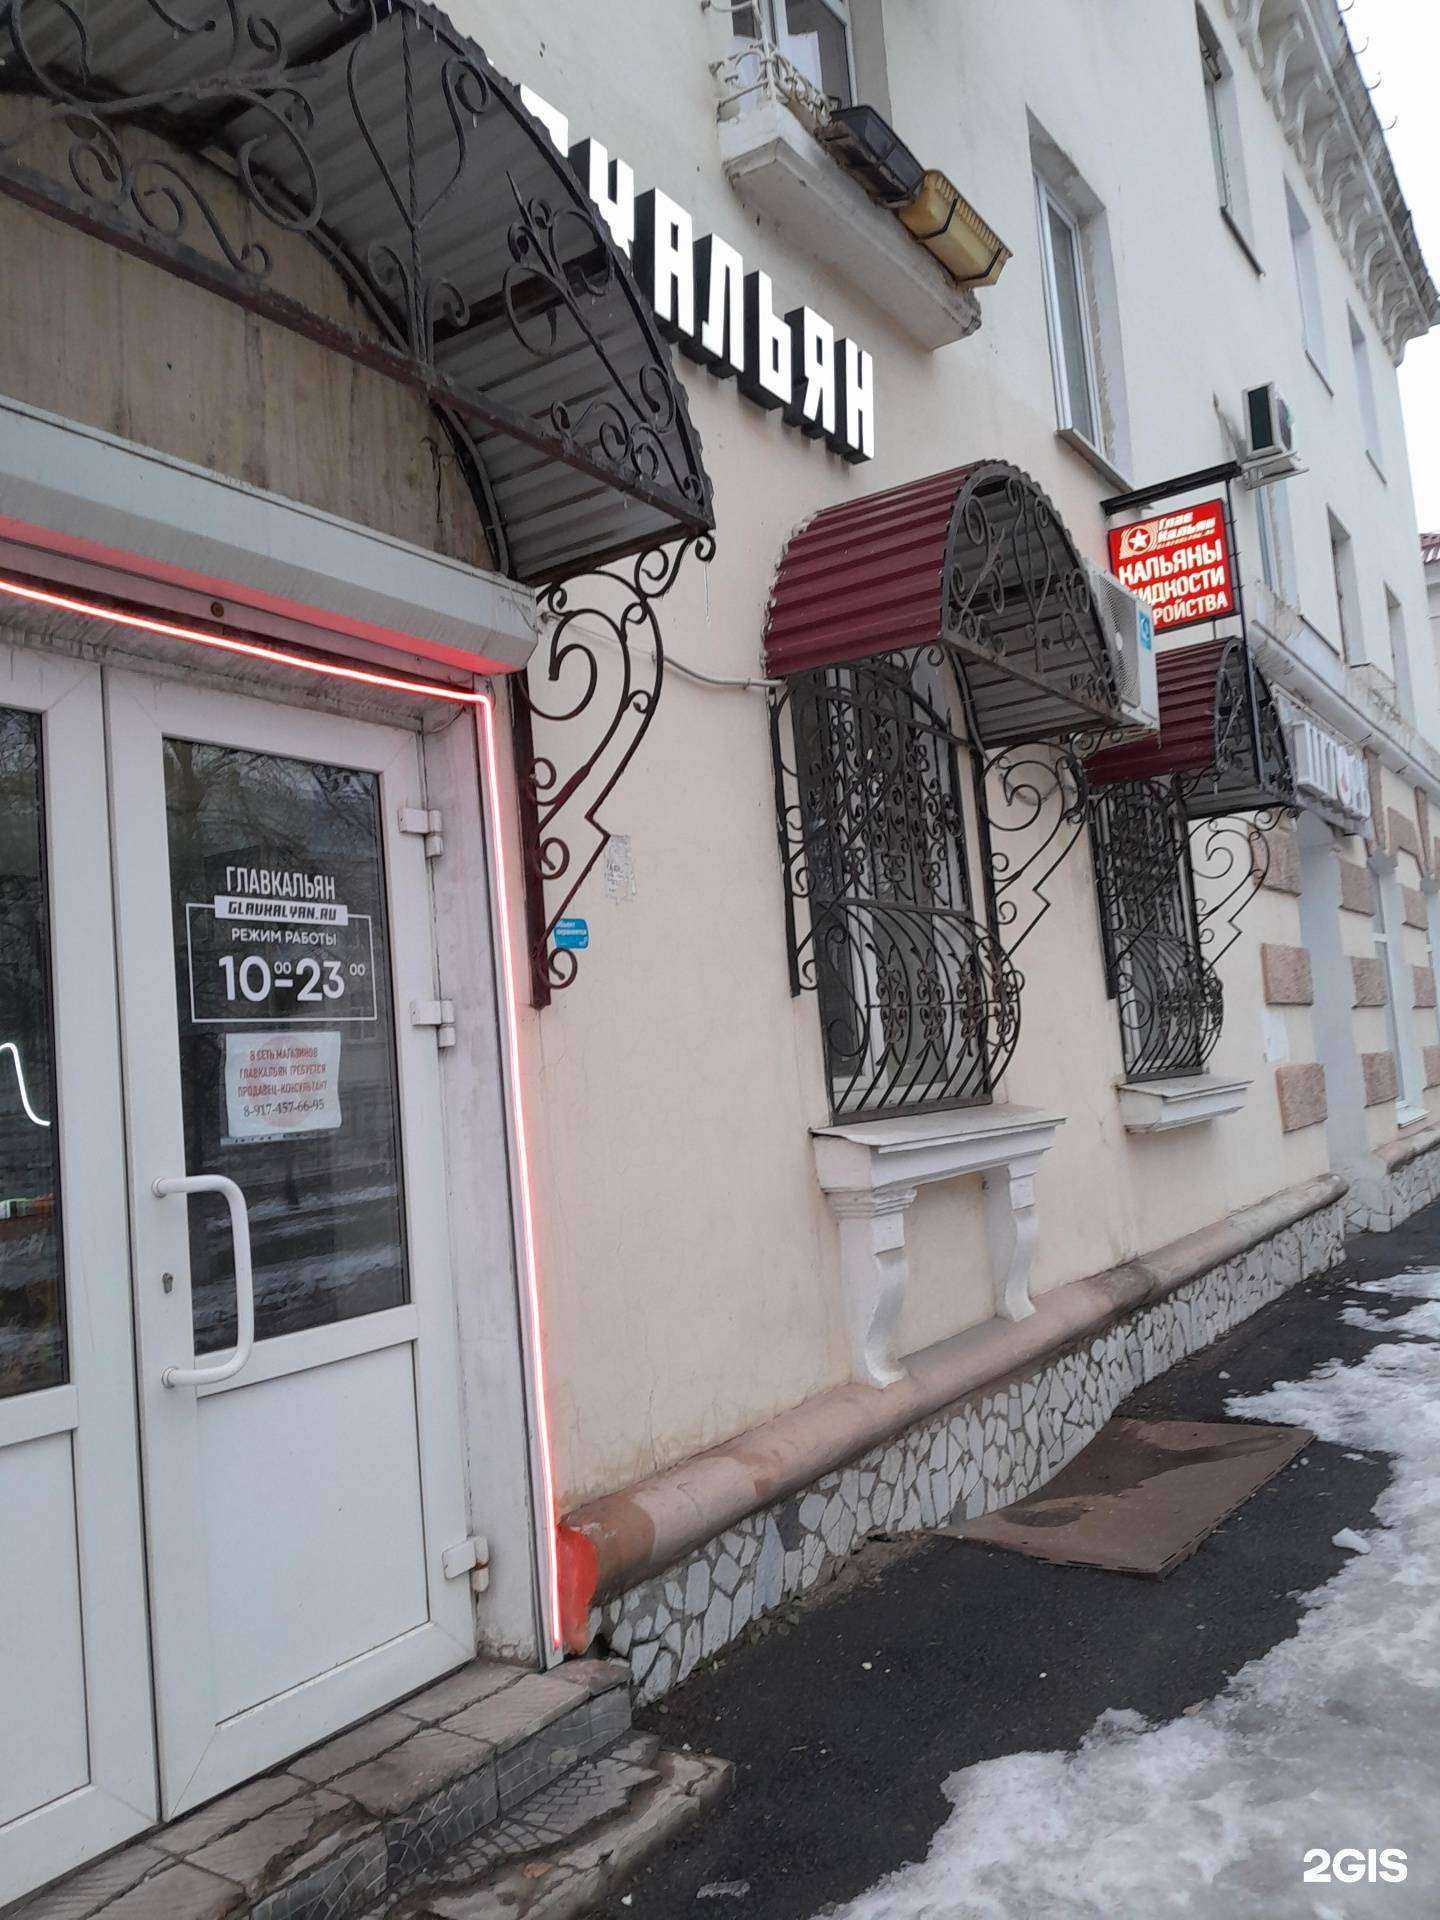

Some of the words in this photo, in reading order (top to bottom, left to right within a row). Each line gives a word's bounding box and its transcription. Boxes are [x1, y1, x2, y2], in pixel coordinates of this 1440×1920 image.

[1118, 539, 1223, 586] КАЛЬЯНЫ
[1133, 566, 1226, 606] ИДКОСТИ
[1152, 591, 1229, 625] РОЙСТВА
[226, 866, 336, 900] ГЛАВКАЛЬЯН
[232, 928, 282, 943] РЕЖИМ
[285, 931, 337, 946] РАБОТЫ
